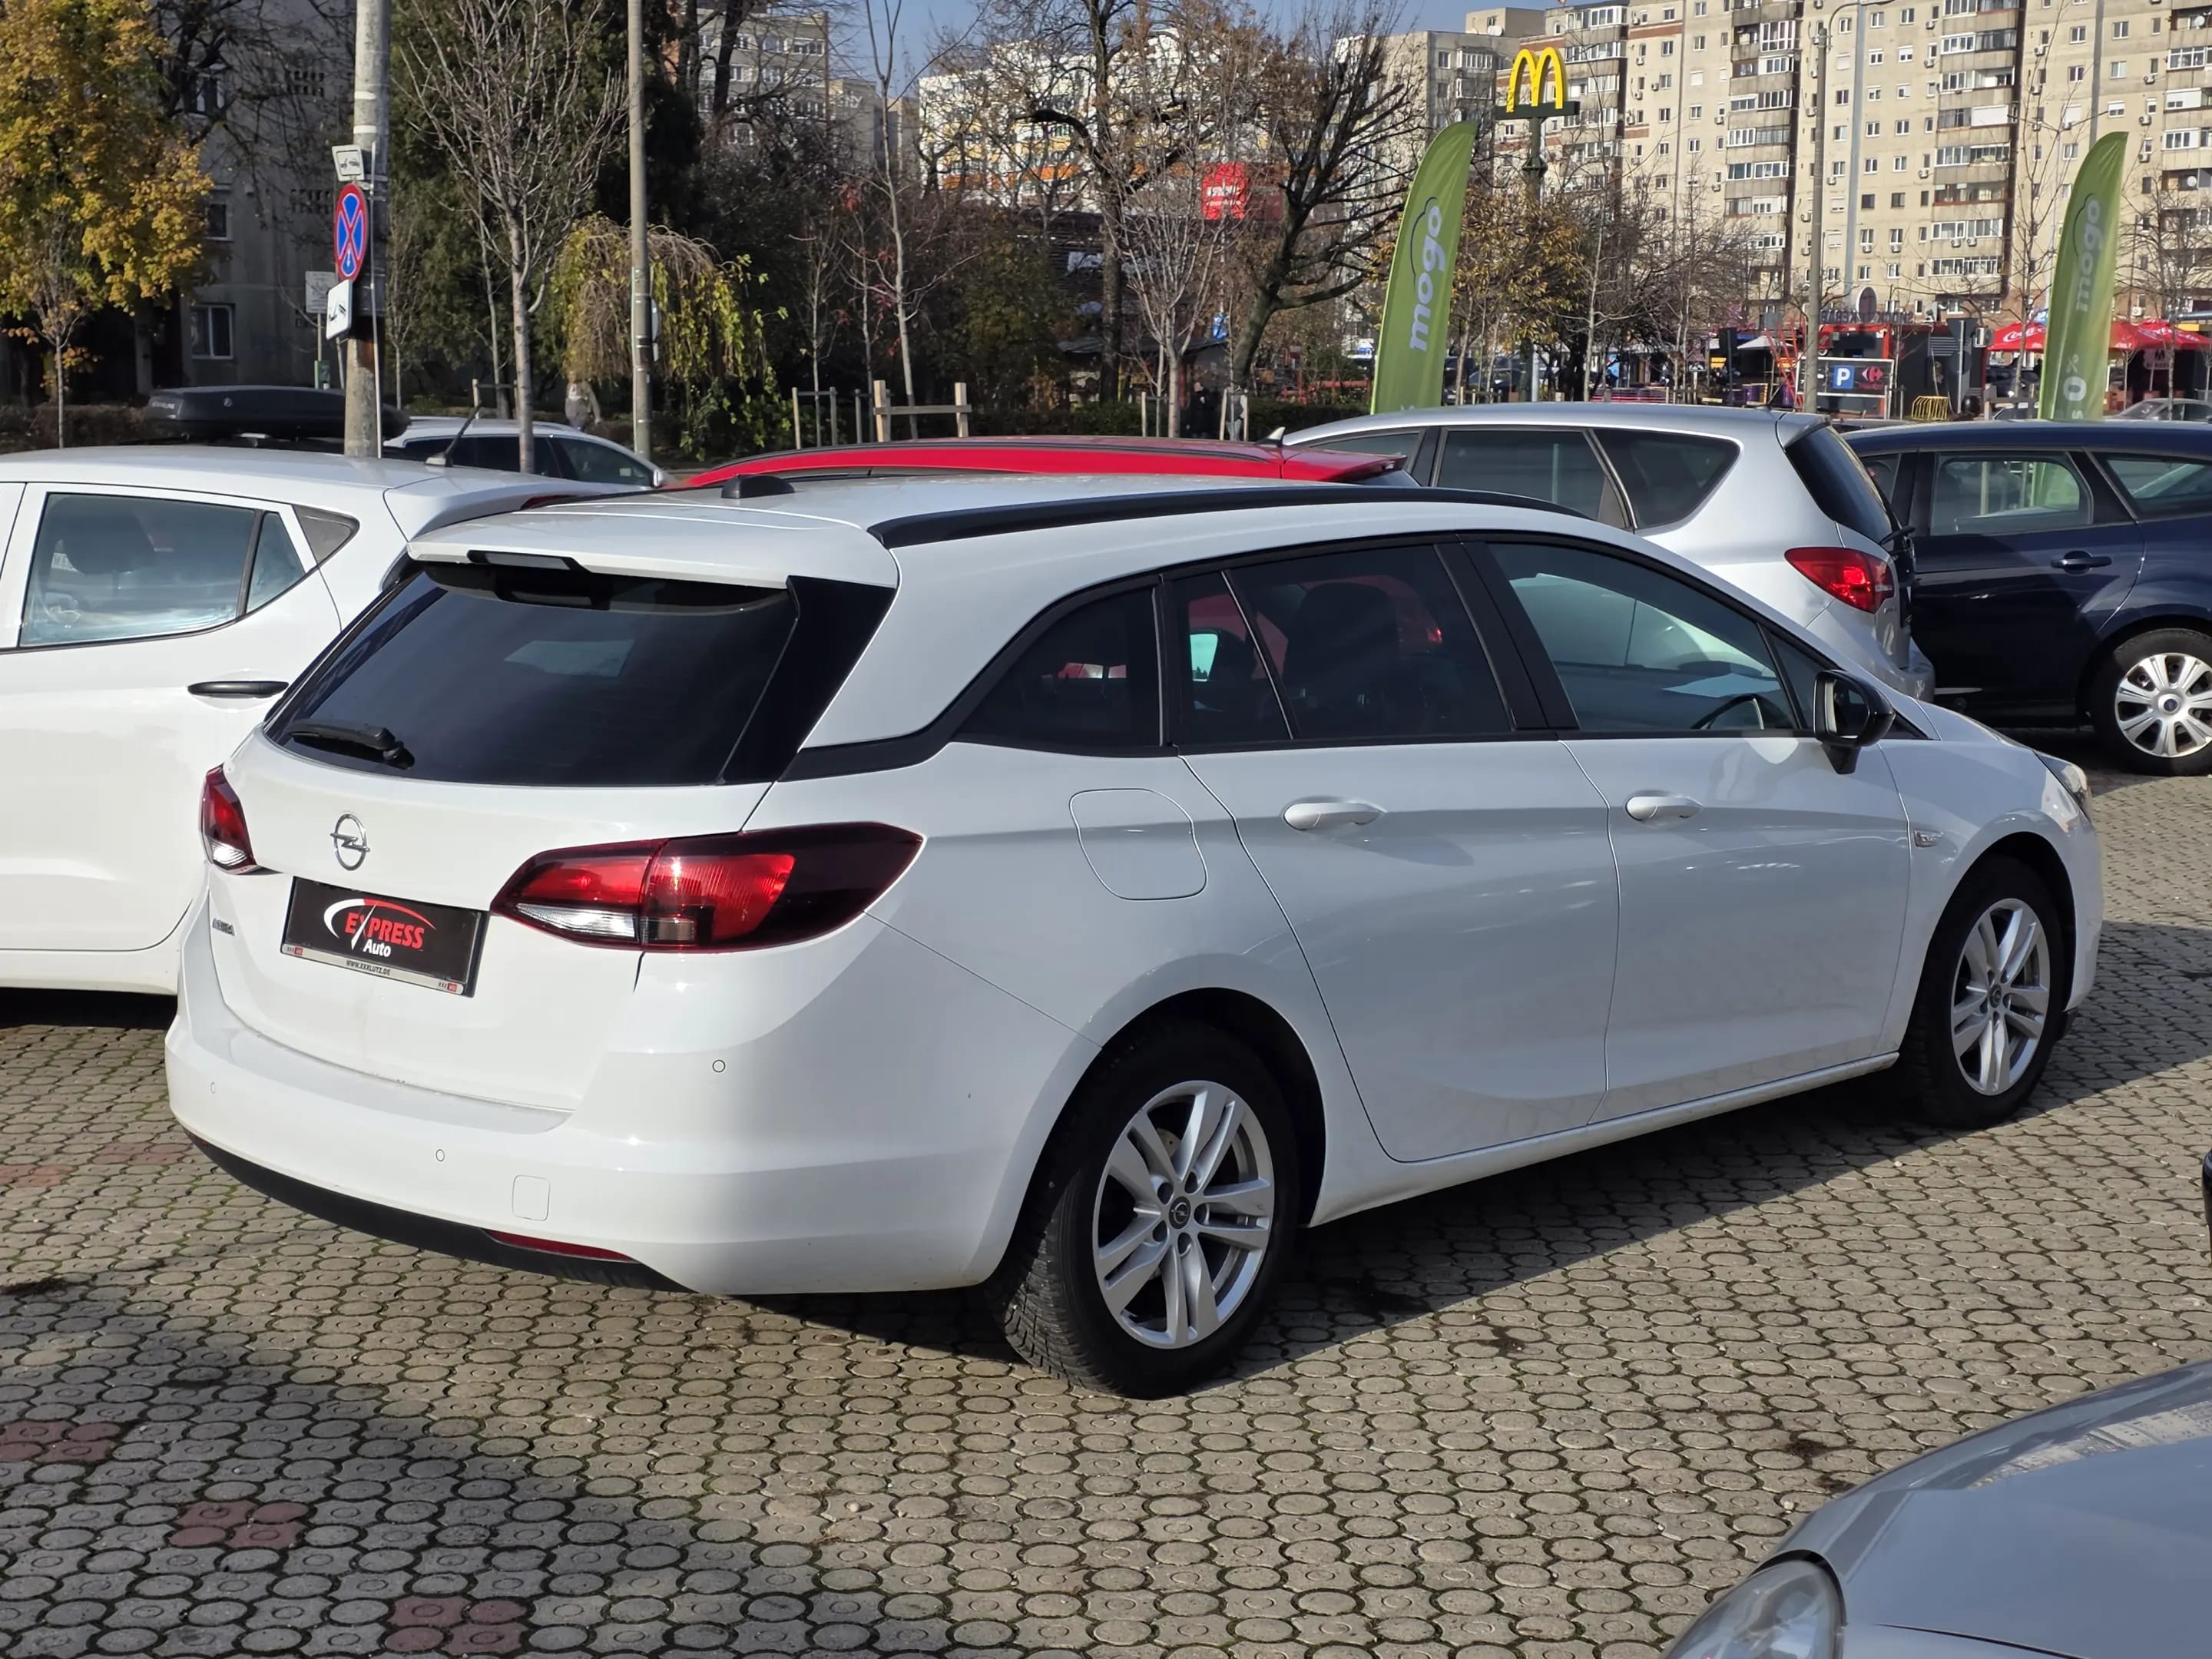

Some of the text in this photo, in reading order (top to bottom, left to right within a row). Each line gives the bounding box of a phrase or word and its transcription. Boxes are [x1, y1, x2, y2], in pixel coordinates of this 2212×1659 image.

[2075, 199, 2103, 313] mogo
[1409, 205, 1445, 352] mogo
[1836, 368, 1850, 386] P
[345, 912, 424, 949] EXPRESS
[363, 939, 391, 958] Auto
